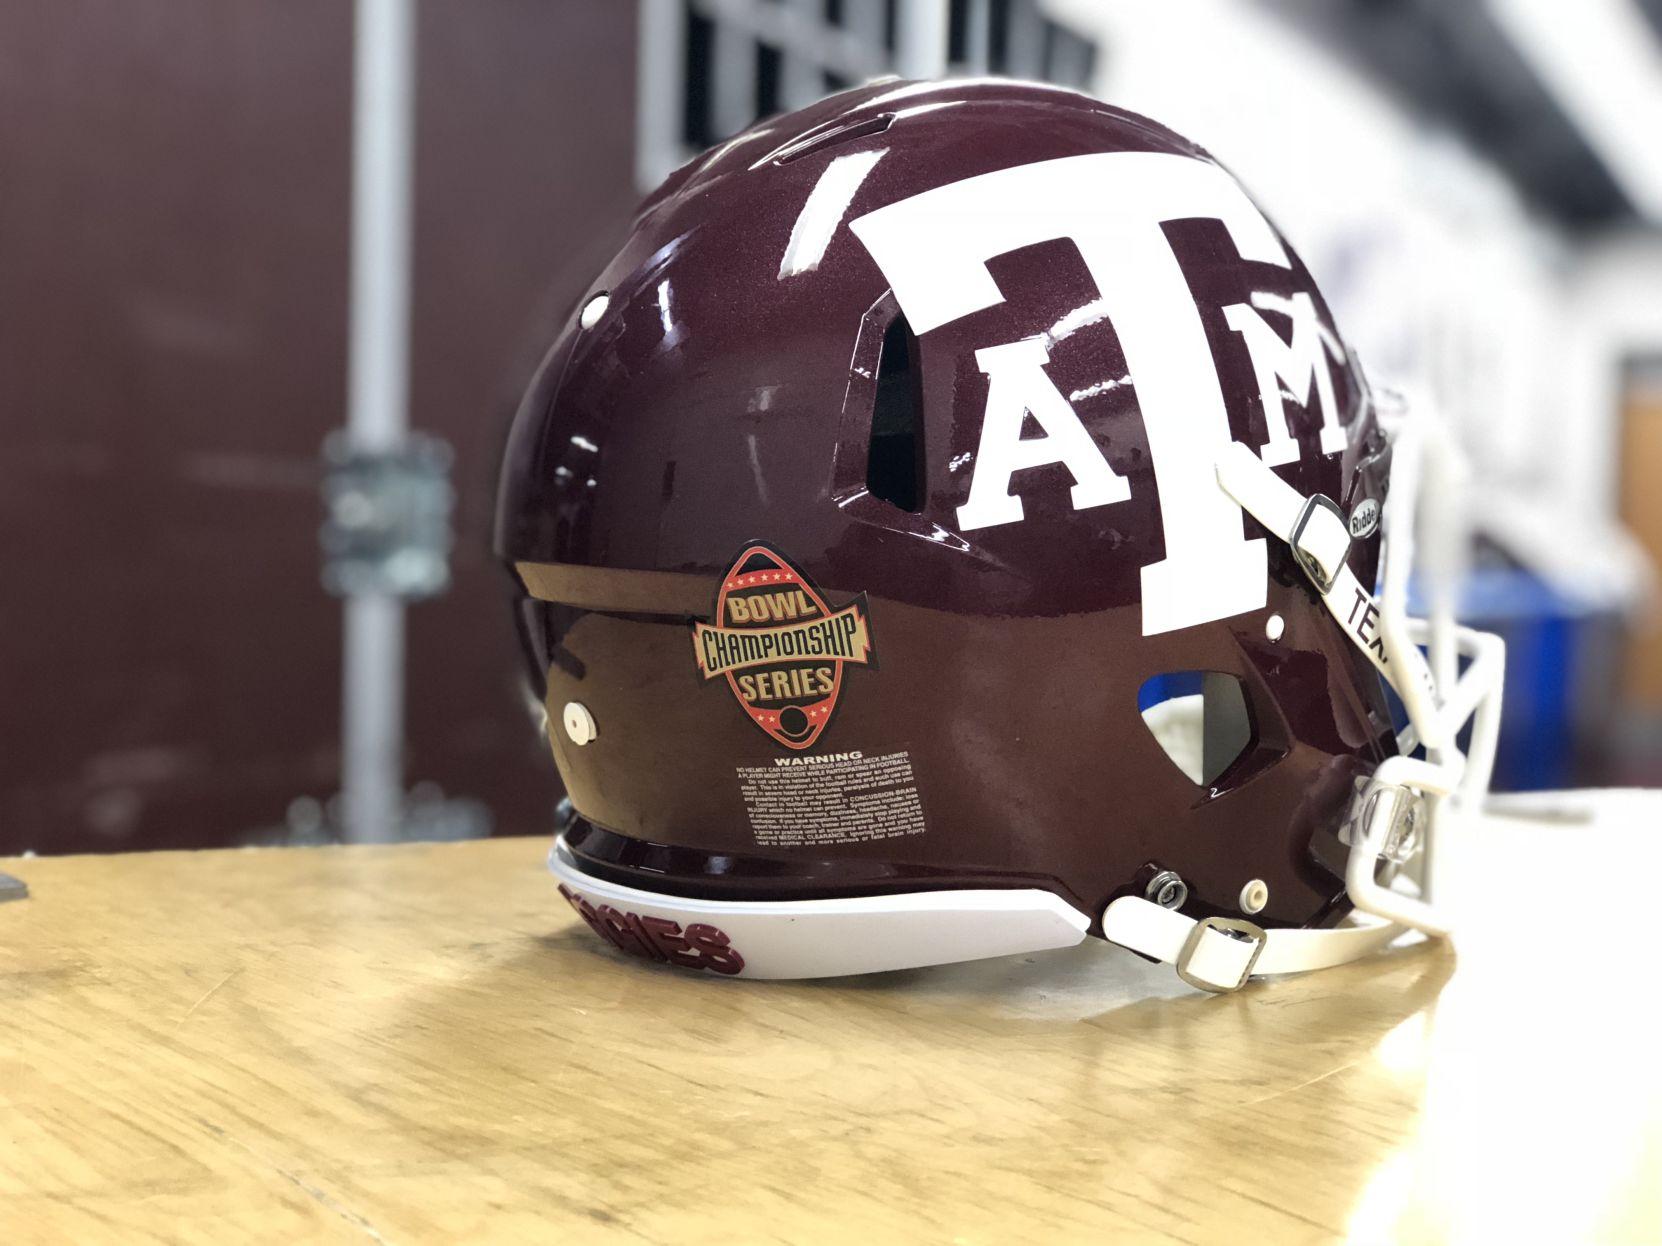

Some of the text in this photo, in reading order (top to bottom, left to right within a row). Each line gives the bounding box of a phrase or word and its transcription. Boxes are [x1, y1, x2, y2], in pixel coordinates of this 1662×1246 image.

[726, 591, 817, 624] BOWL
[702, 613, 857, 672] CHAMPIONSHIP
[738, 667, 834, 702] SERIES
[774, 751, 863, 766] WARNING
